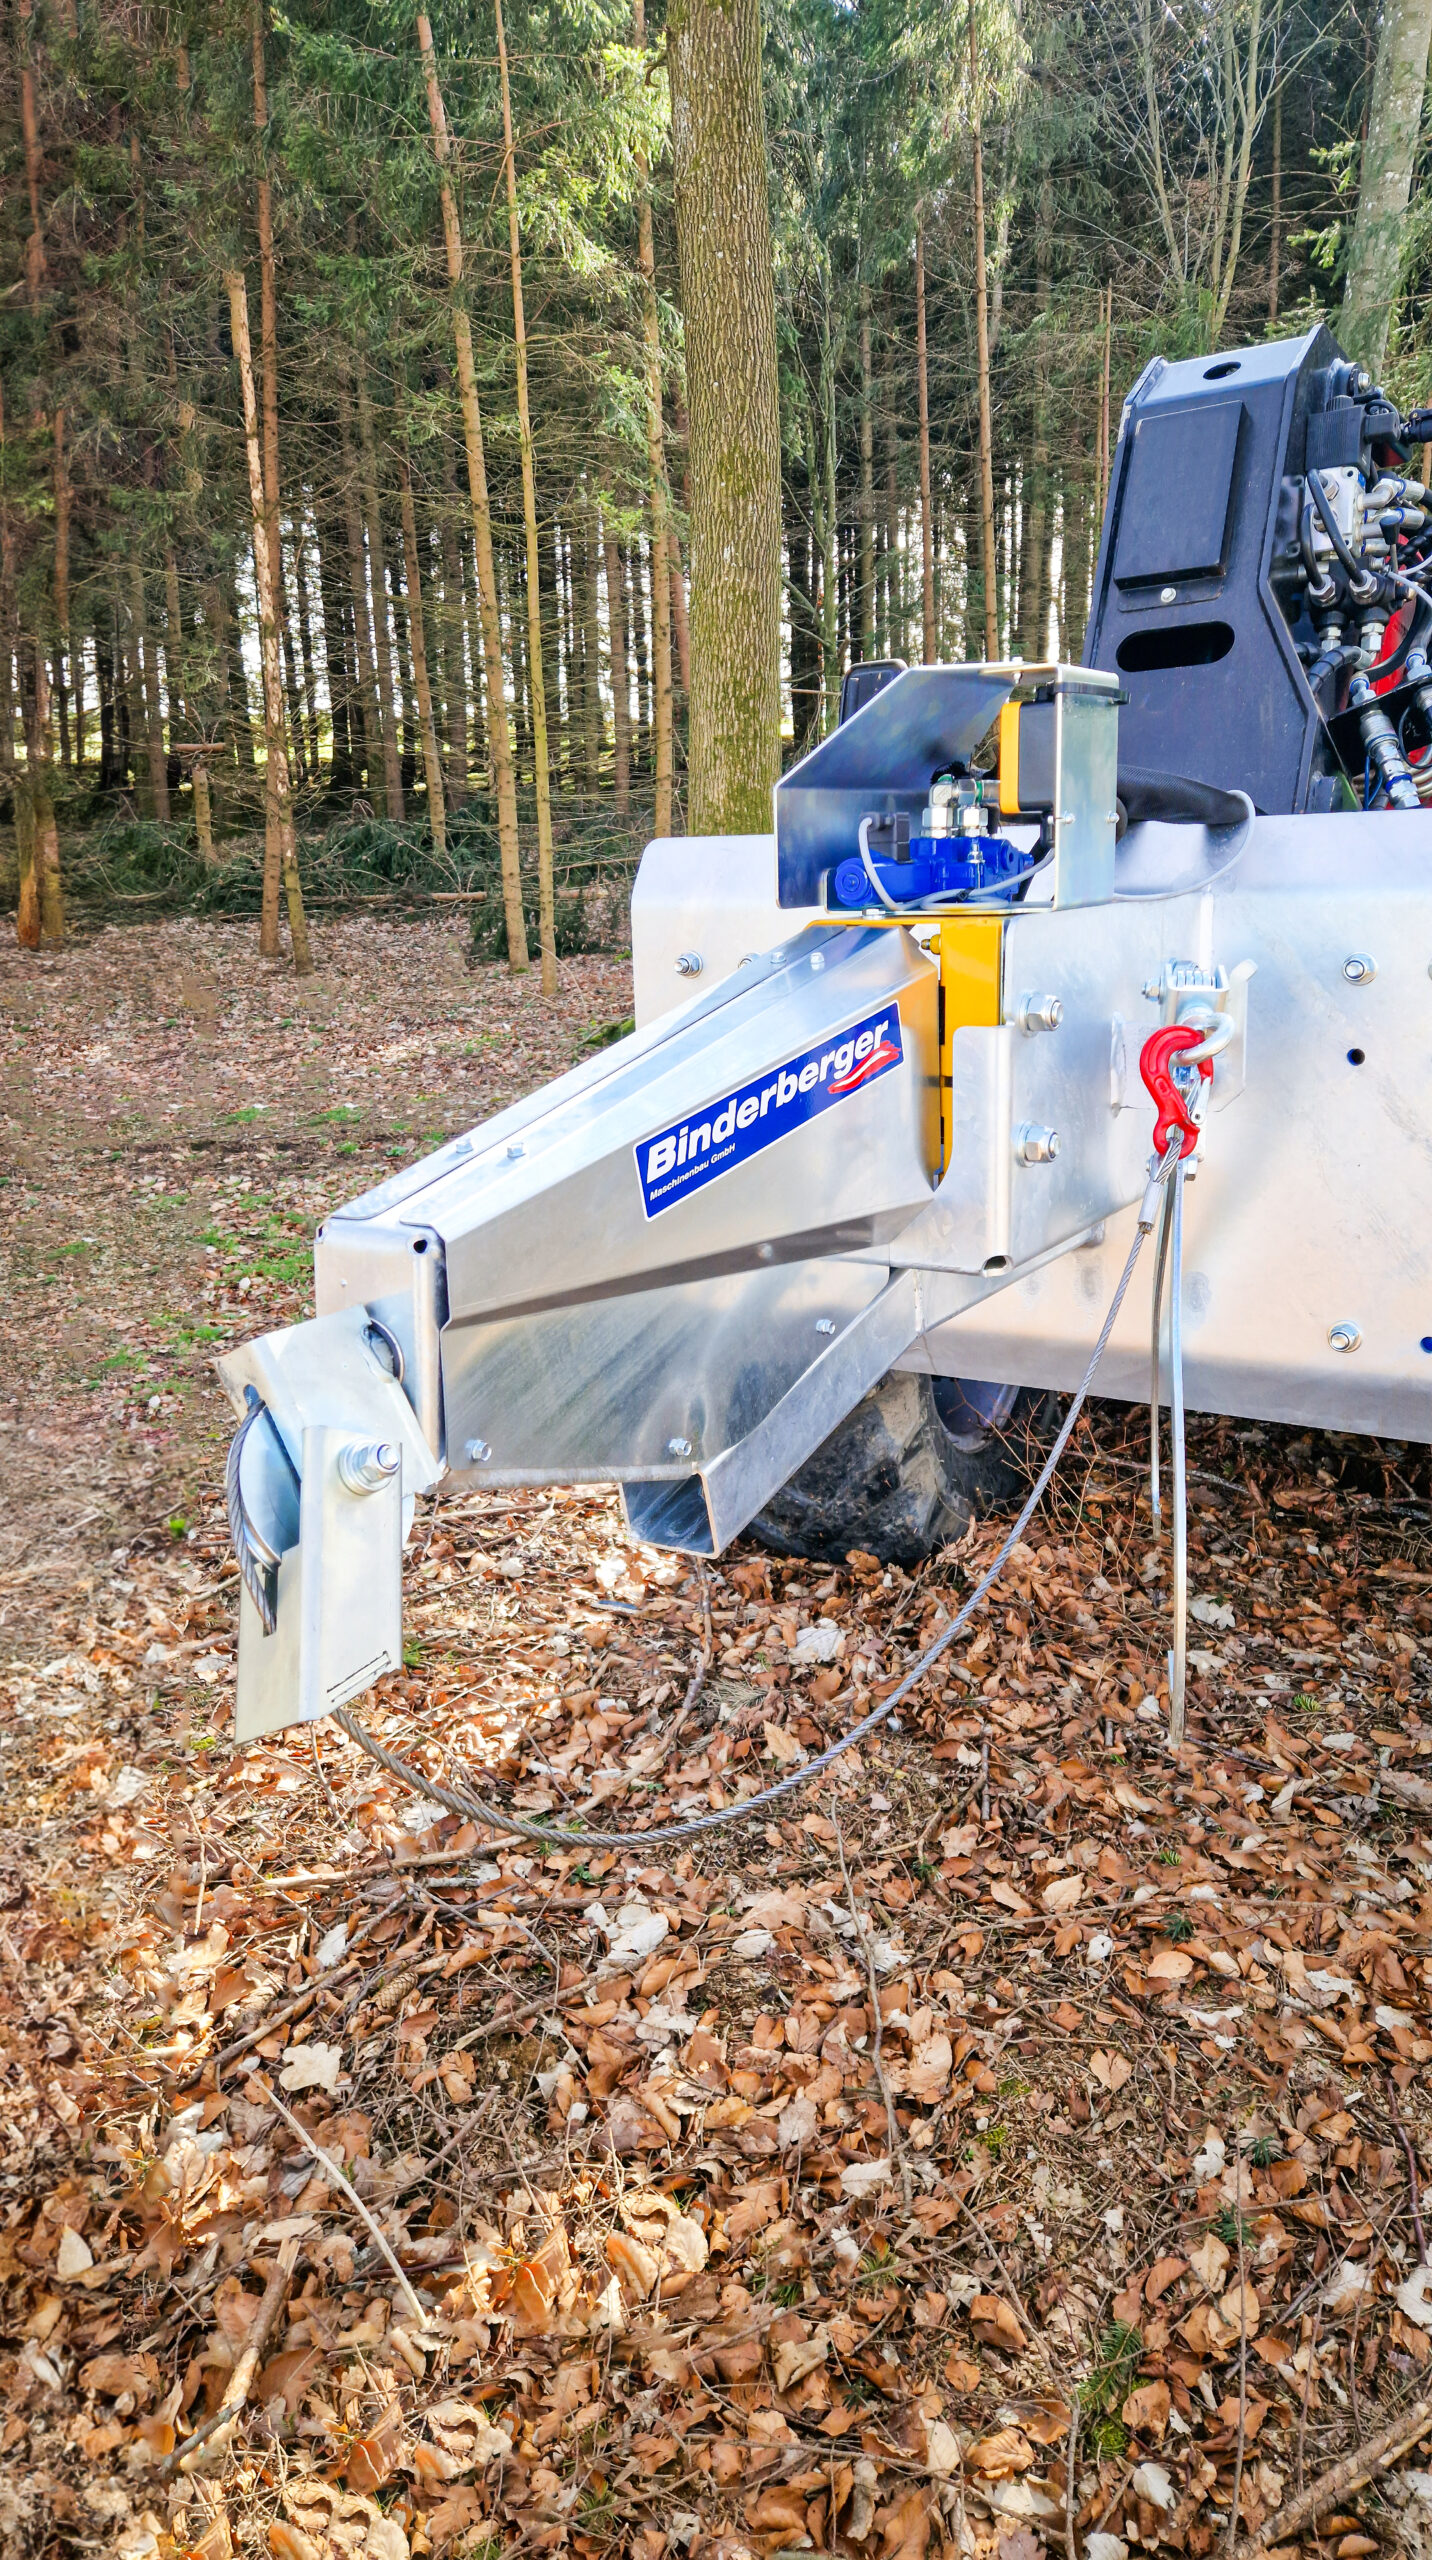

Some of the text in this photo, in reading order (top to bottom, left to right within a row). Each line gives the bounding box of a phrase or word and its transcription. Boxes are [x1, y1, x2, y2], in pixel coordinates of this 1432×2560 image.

[647, 1020, 888, 1183] Binderberger
[650, 1143, 736, 1201] Maschinenbau GmbH
